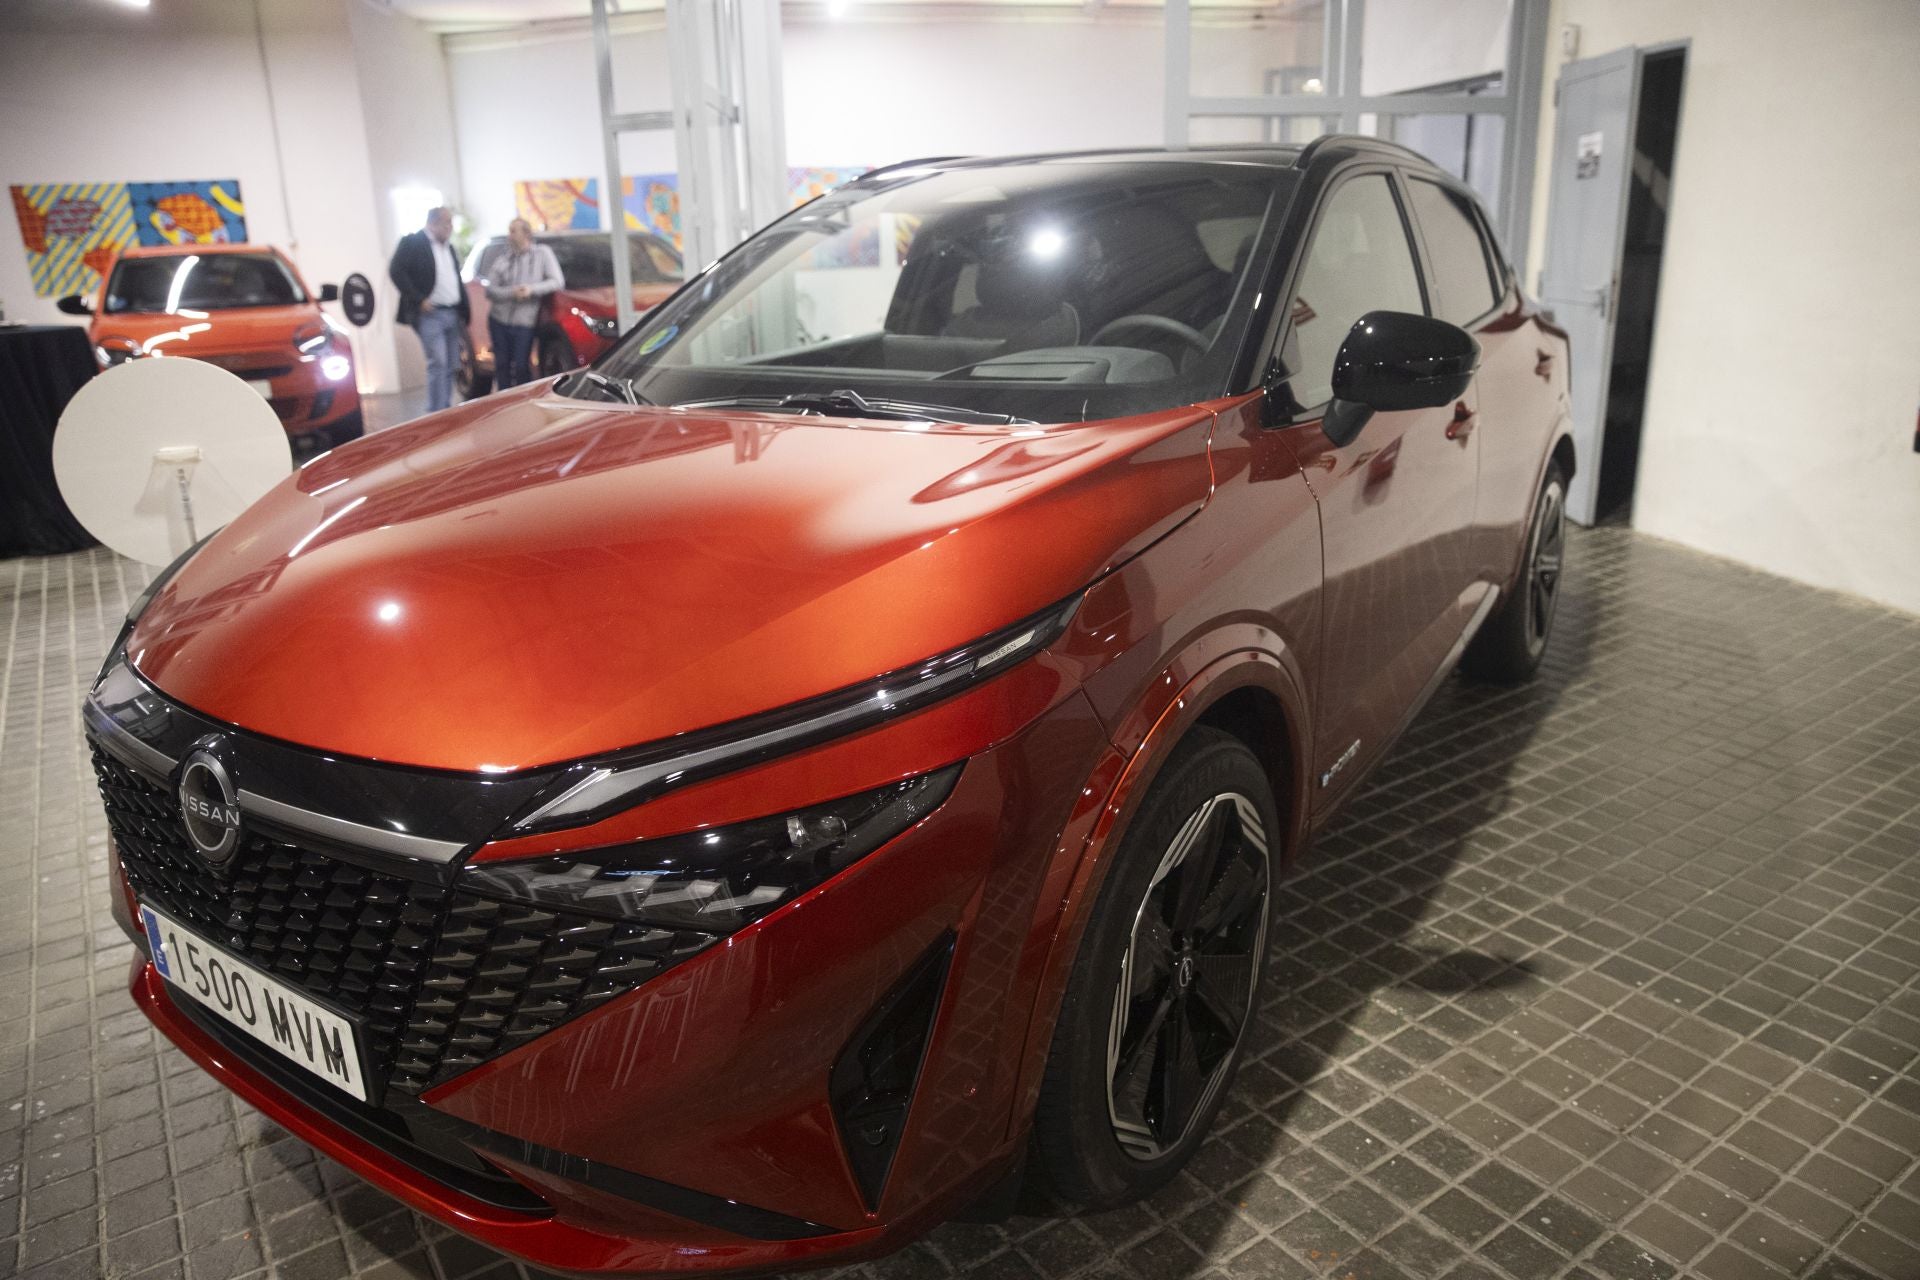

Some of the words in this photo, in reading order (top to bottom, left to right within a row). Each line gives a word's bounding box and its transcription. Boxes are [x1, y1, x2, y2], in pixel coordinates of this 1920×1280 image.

[178, 786, 240, 826] NISSAN
[156, 950, 165, 964] E
[169, 931, 257, 1026] 1500
[263, 988, 351, 1083] MVM
